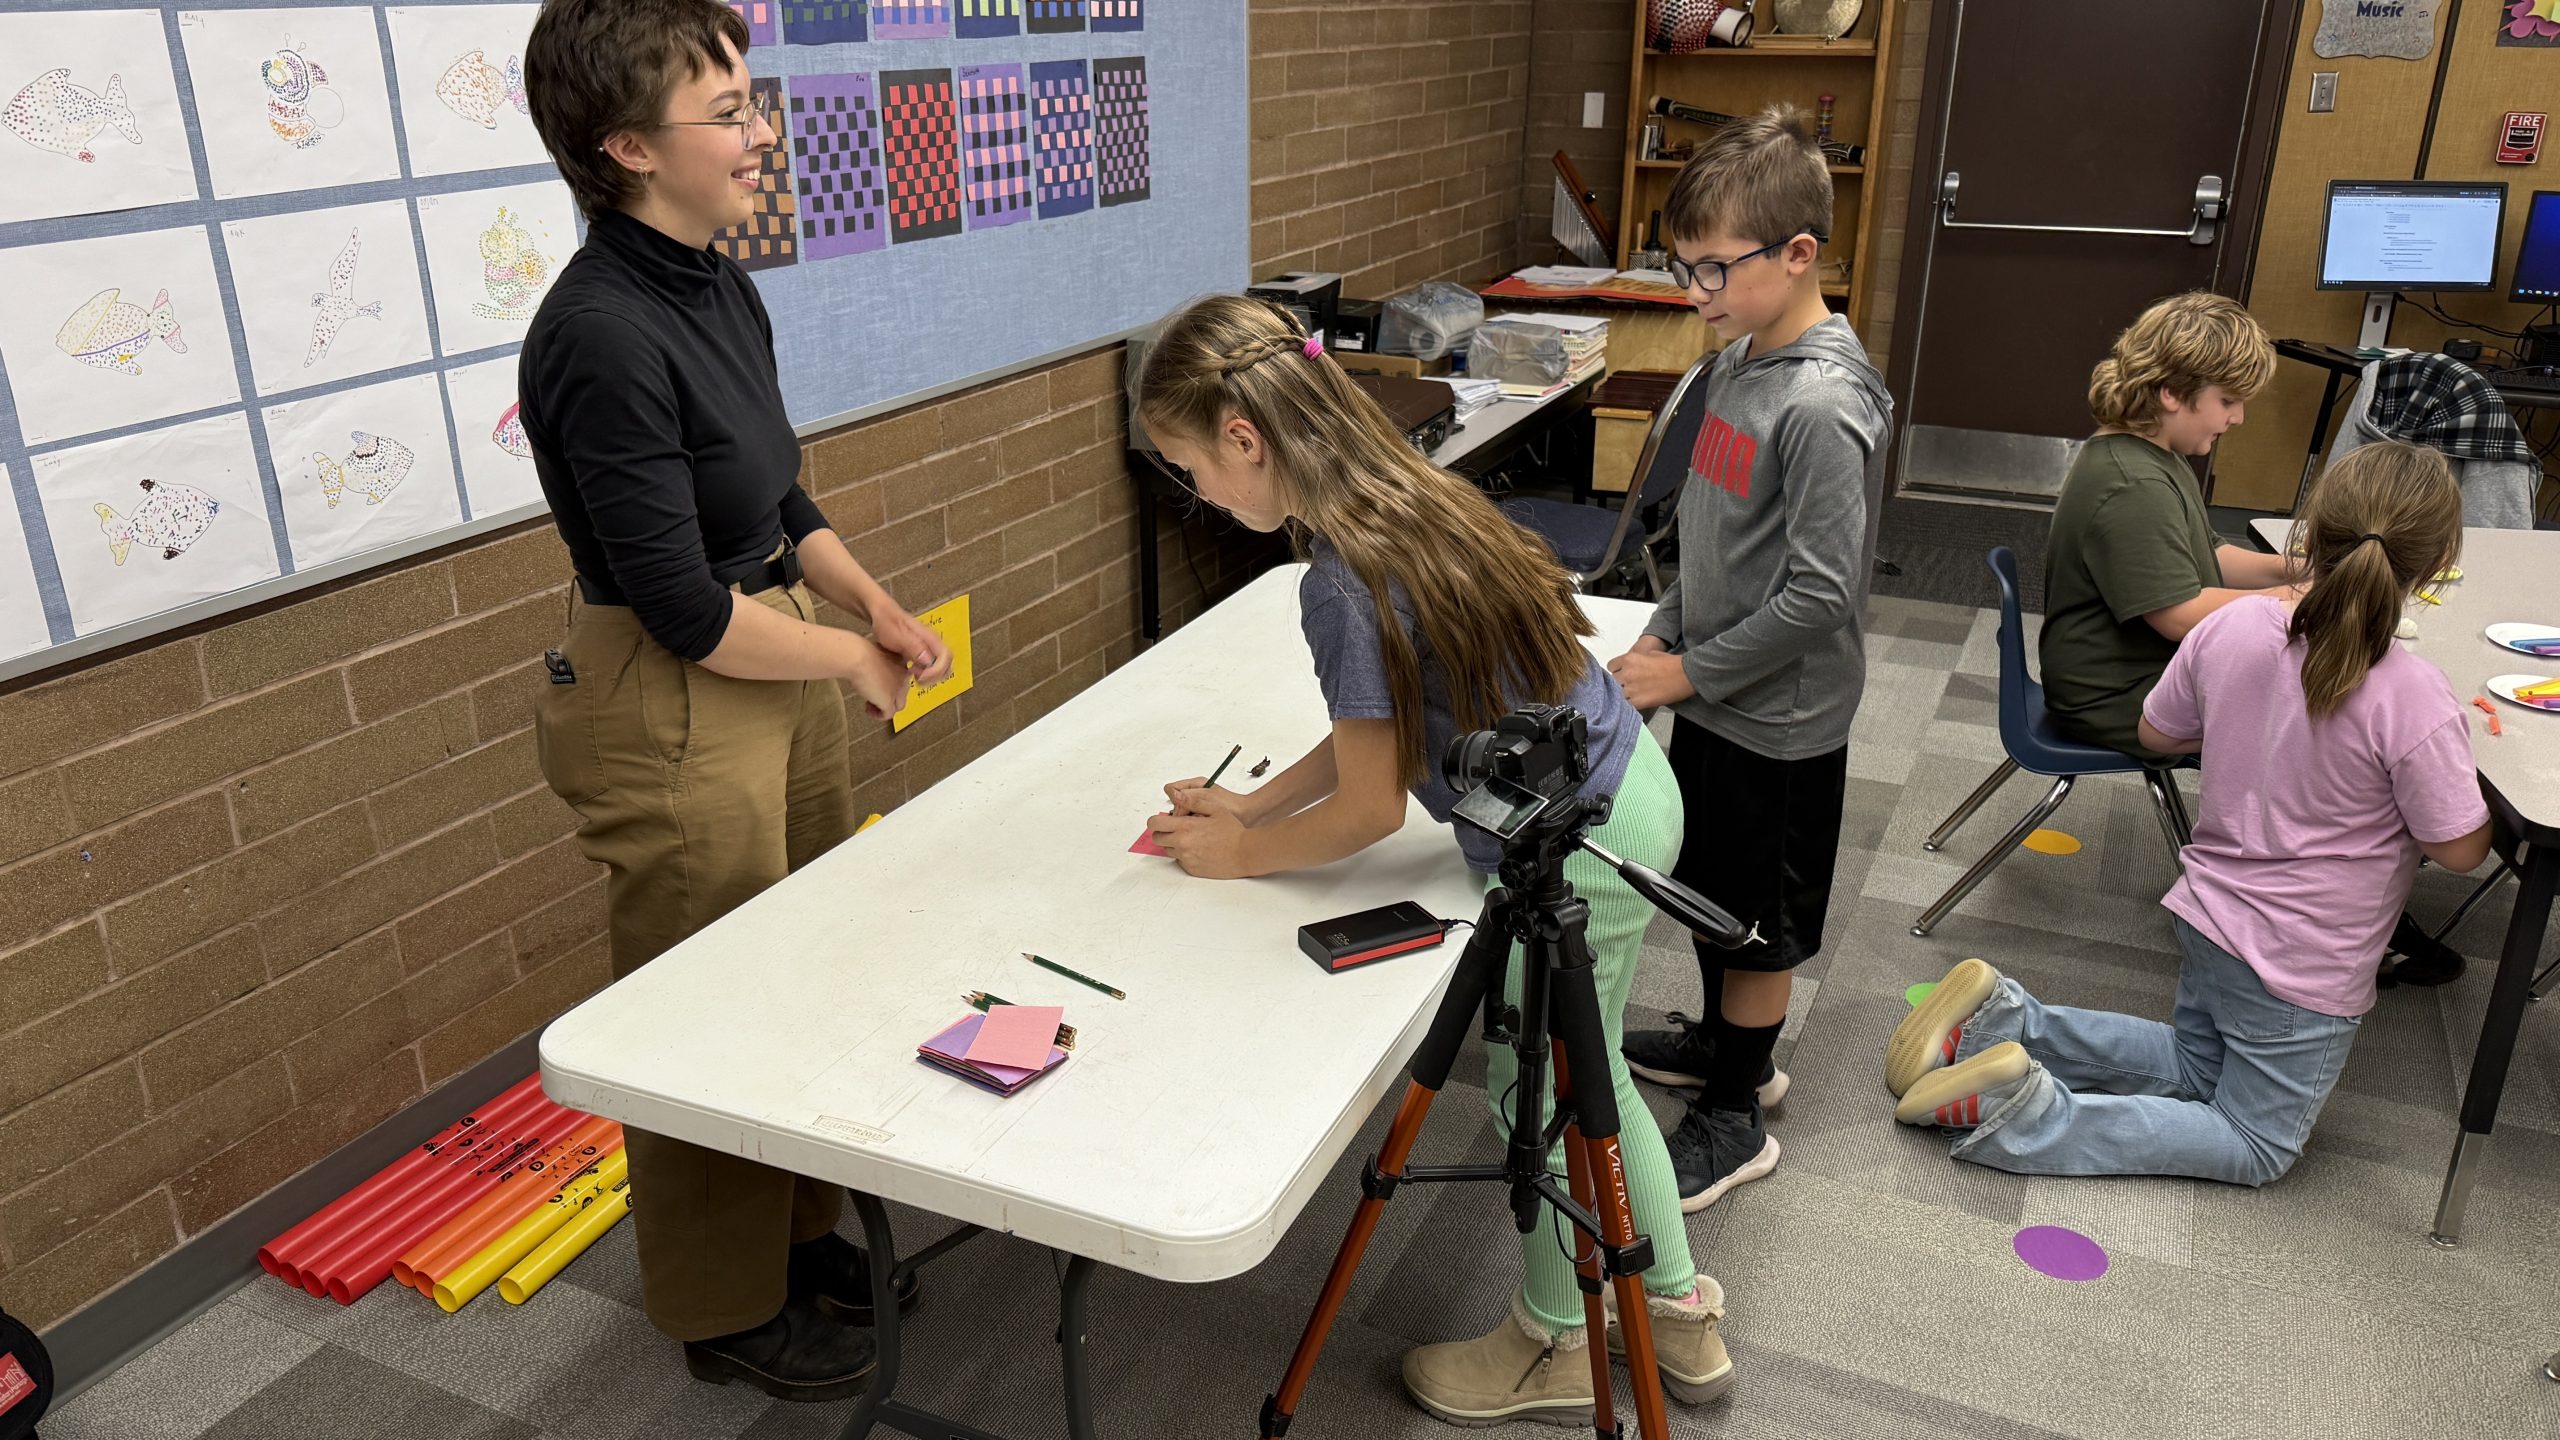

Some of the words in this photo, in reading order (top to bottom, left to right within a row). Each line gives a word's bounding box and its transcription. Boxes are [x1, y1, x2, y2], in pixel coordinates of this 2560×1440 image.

[2356, 0, 2405, 17] Music
[2509, 115, 2542, 127] FIRE
[1621, 1214, 1633, 1241] NT70
